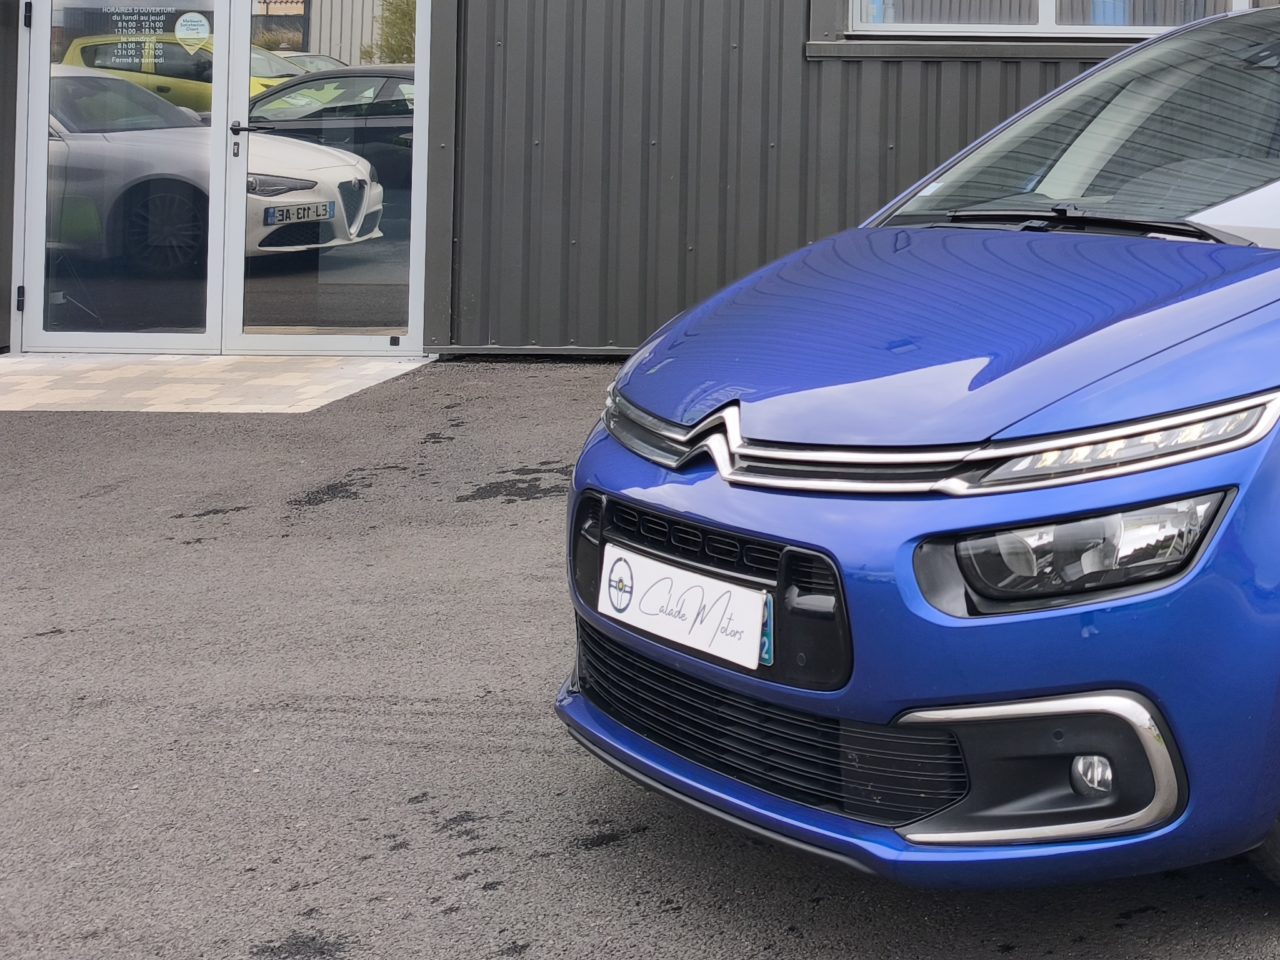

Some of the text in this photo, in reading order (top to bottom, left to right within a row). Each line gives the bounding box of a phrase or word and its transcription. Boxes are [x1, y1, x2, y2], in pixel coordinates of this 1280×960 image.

[149, 14, 166, 22] jeudi
[638, 576, 745, 648] Calade Motors
